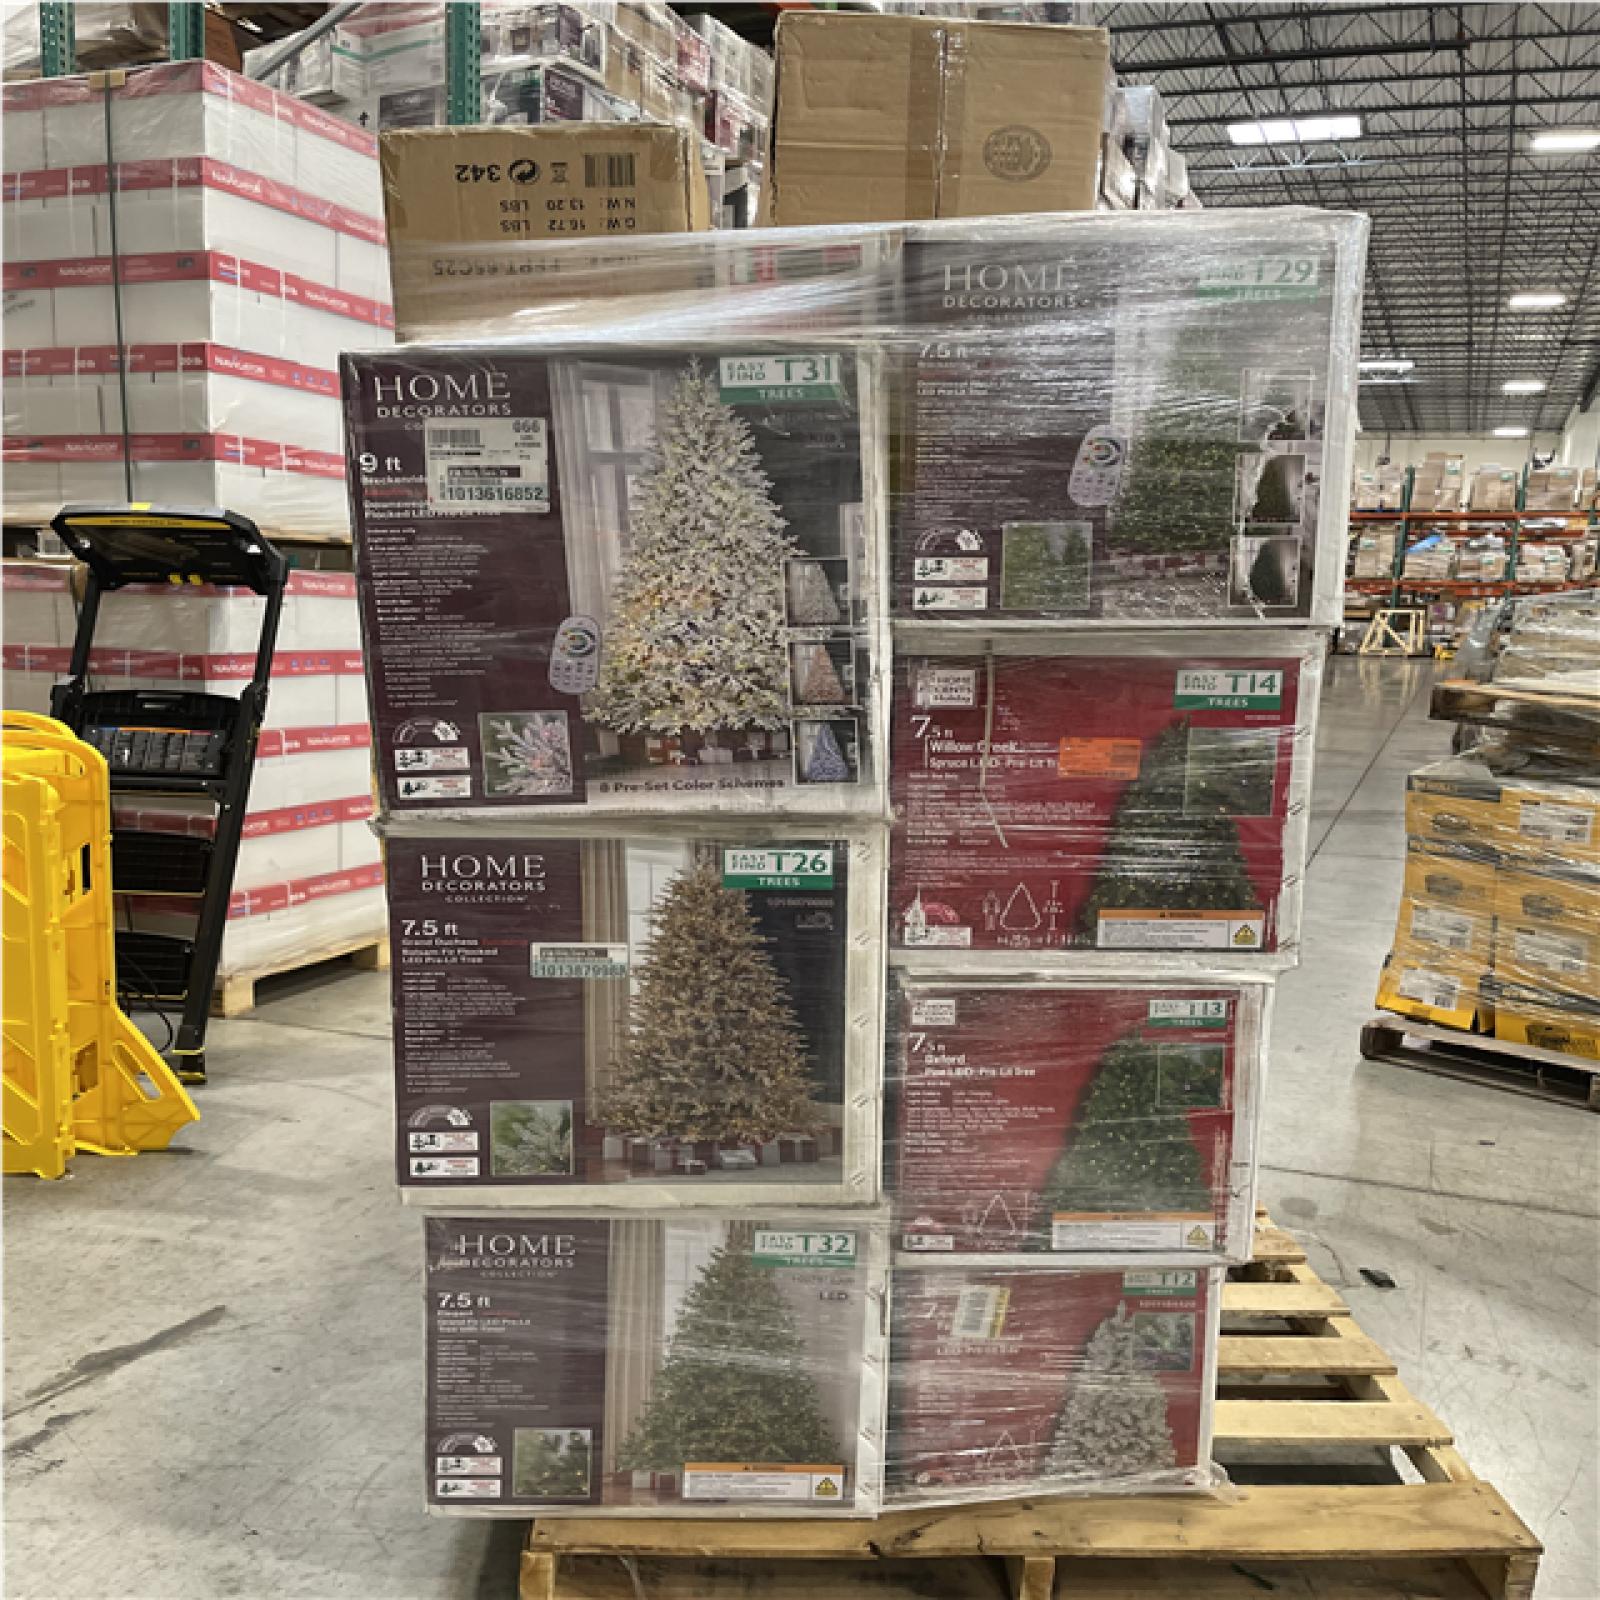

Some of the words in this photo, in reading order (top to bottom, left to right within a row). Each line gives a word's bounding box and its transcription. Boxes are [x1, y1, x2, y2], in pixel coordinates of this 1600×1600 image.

[454, 164, 501, 183] 342
[944, 264, 1078, 291] HOME
[1254, 259, 1313, 283] T29
[943, 295, 1076, 308] DECORATORS
[774, 358, 831, 383] T31
[374, 371, 511, 401] HOME
[377, 403, 511, 418] DECORATORS
[359, 452, 378, 473] 9
[384, 457, 401, 471] ft
[1184, 674, 1218, 682] EASY
[1224, 673, 1277, 693] T14
[1184, 683, 1218, 691] FIND
[1208, 697, 1249, 707] TREES
[929, 740, 973, 753] Willow
[977, 740, 1018, 753] Ceek
[614, 781, 669, 792] Pre-Set
[672, 779, 715, 791] Color
[719, 776, 784, 790] Schemes
[420, 854, 547, 879] HOME
[767, 851, 828, 873] T26
[421, 880, 546, 891] DECORATORS
[758, 876, 801, 886] TREES
[444, 894, 522, 903] COLLECTION
[401, 919, 438, 936] 7.5
[444, 921, 458, 936] ft
[459, 1234, 576, 1256] HOME
[796, 1234, 851, 1253] T32
[437, 1292, 472, 1309] 7.5
